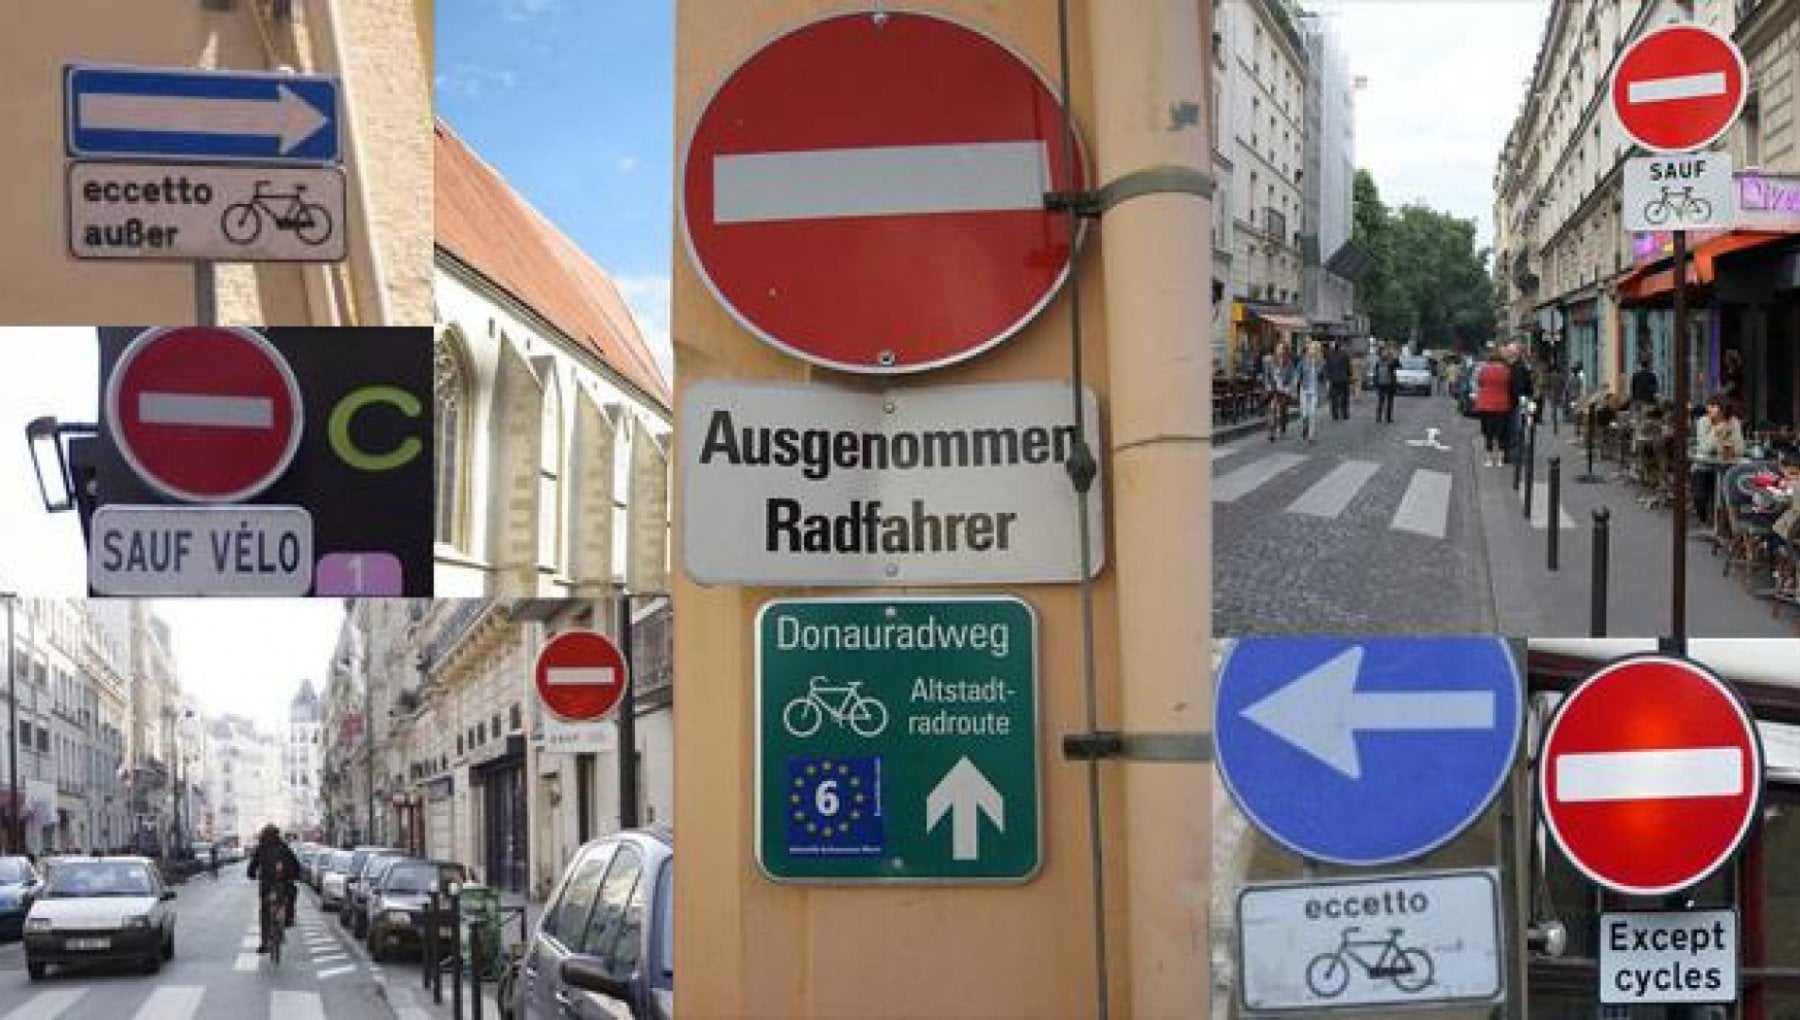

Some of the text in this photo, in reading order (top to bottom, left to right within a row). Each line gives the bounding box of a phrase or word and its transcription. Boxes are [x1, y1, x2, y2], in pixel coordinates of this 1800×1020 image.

[1649, 160, 1706, 181] SAUF
[84, 175, 213, 204] eccetto
[86, 217, 179, 247] außer
[328, 385, 423, 471] C
[699, 409, 1080, 481] Ausgenommen
[765, 498, 1019, 554] Radfahrer
[102, 520, 299, 573] SAUF VÉLO
[776, 614, 1010, 657] Donauradweg
[911, 676, 1017, 703] Altstadt-
[908, 711, 1010, 736] radroute
[815, 780, 840, 816] 6
[1304, 889, 1429, 919] eccetto
[1610, 920, 1726, 956] Except
[1614, 961, 1721, 997] cycles
